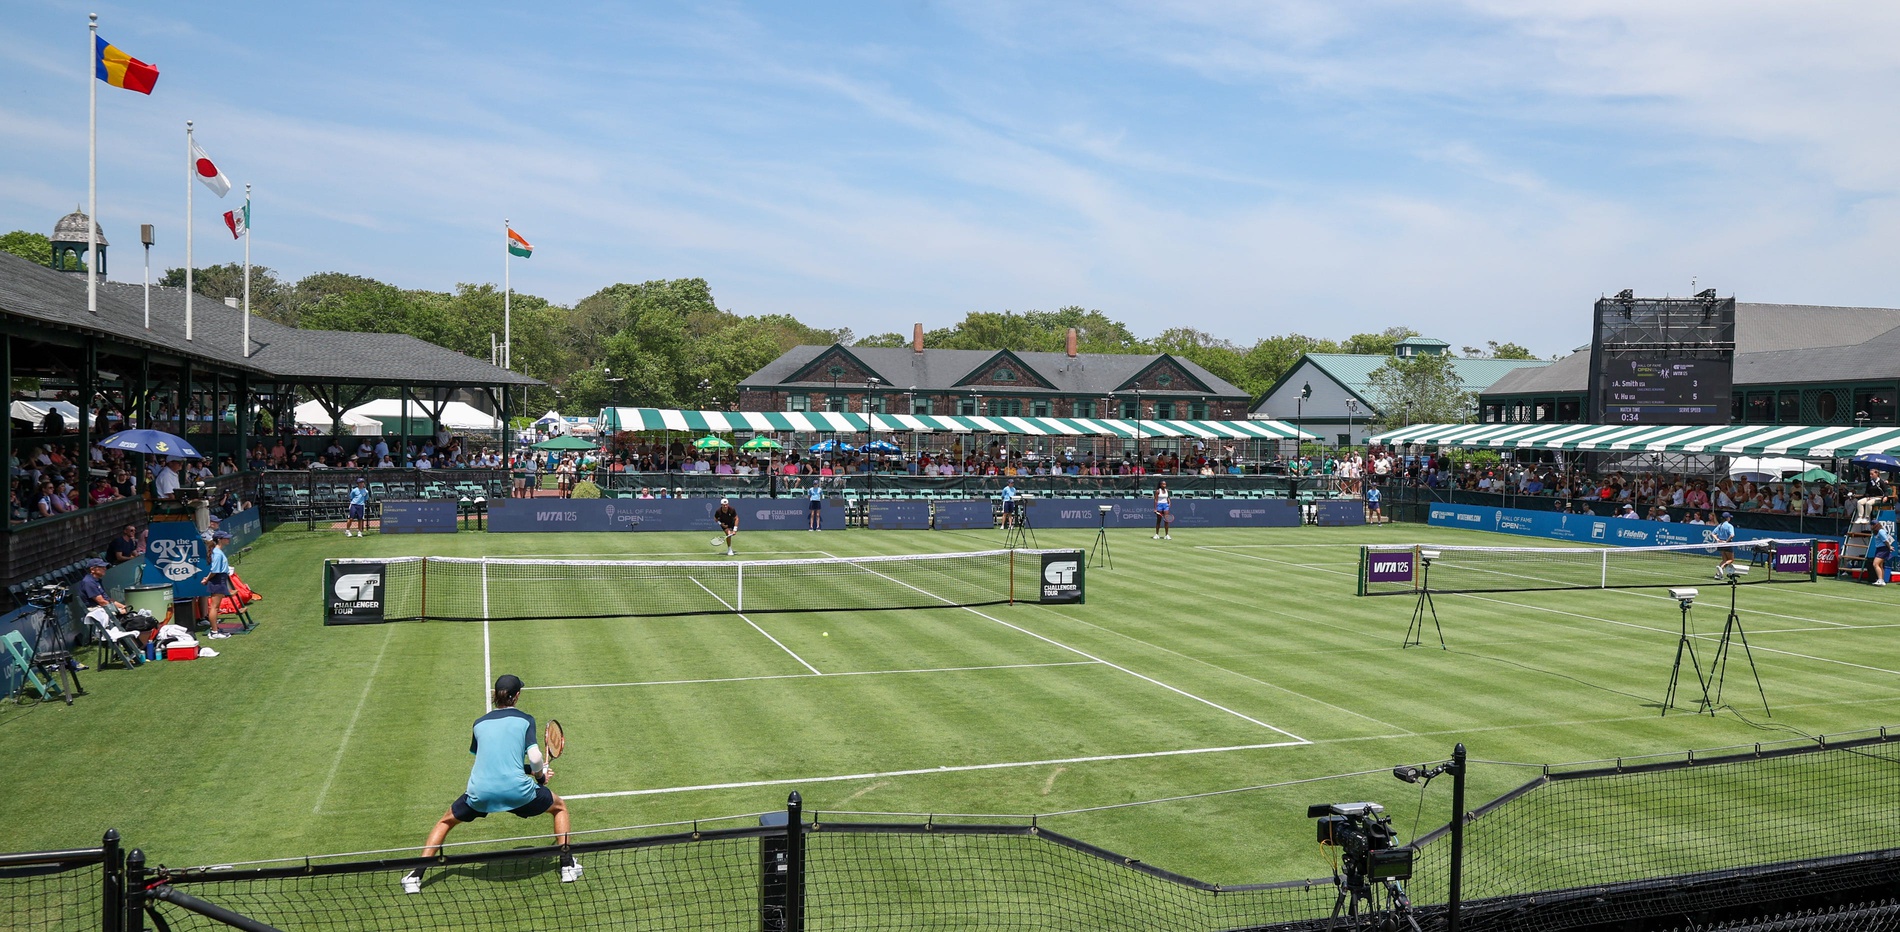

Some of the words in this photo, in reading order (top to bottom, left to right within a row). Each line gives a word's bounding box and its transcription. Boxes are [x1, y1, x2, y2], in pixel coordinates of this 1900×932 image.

[1621, 413, 1639, 421] 0:34
[537, 511, 562, 521] WTA
[564, 511, 577, 521] 125
[1060, 510, 1081, 519] WTA
[1082, 510, 1092, 519] 125
[1501, 521, 1519, 529] OPEN
[1623, 529, 1649, 540] Fidelity
[150, 540, 200, 564] Ryl
[1780, 554, 1797, 564] WTA
[1797, 554, 1806, 564] 125
[168, 565, 190, 575] tea
[1374, 562, 1396, 573] WTA
[1397, 562, 1409, 572] 125
[334, 601, 379, 609] CHALLENGER
